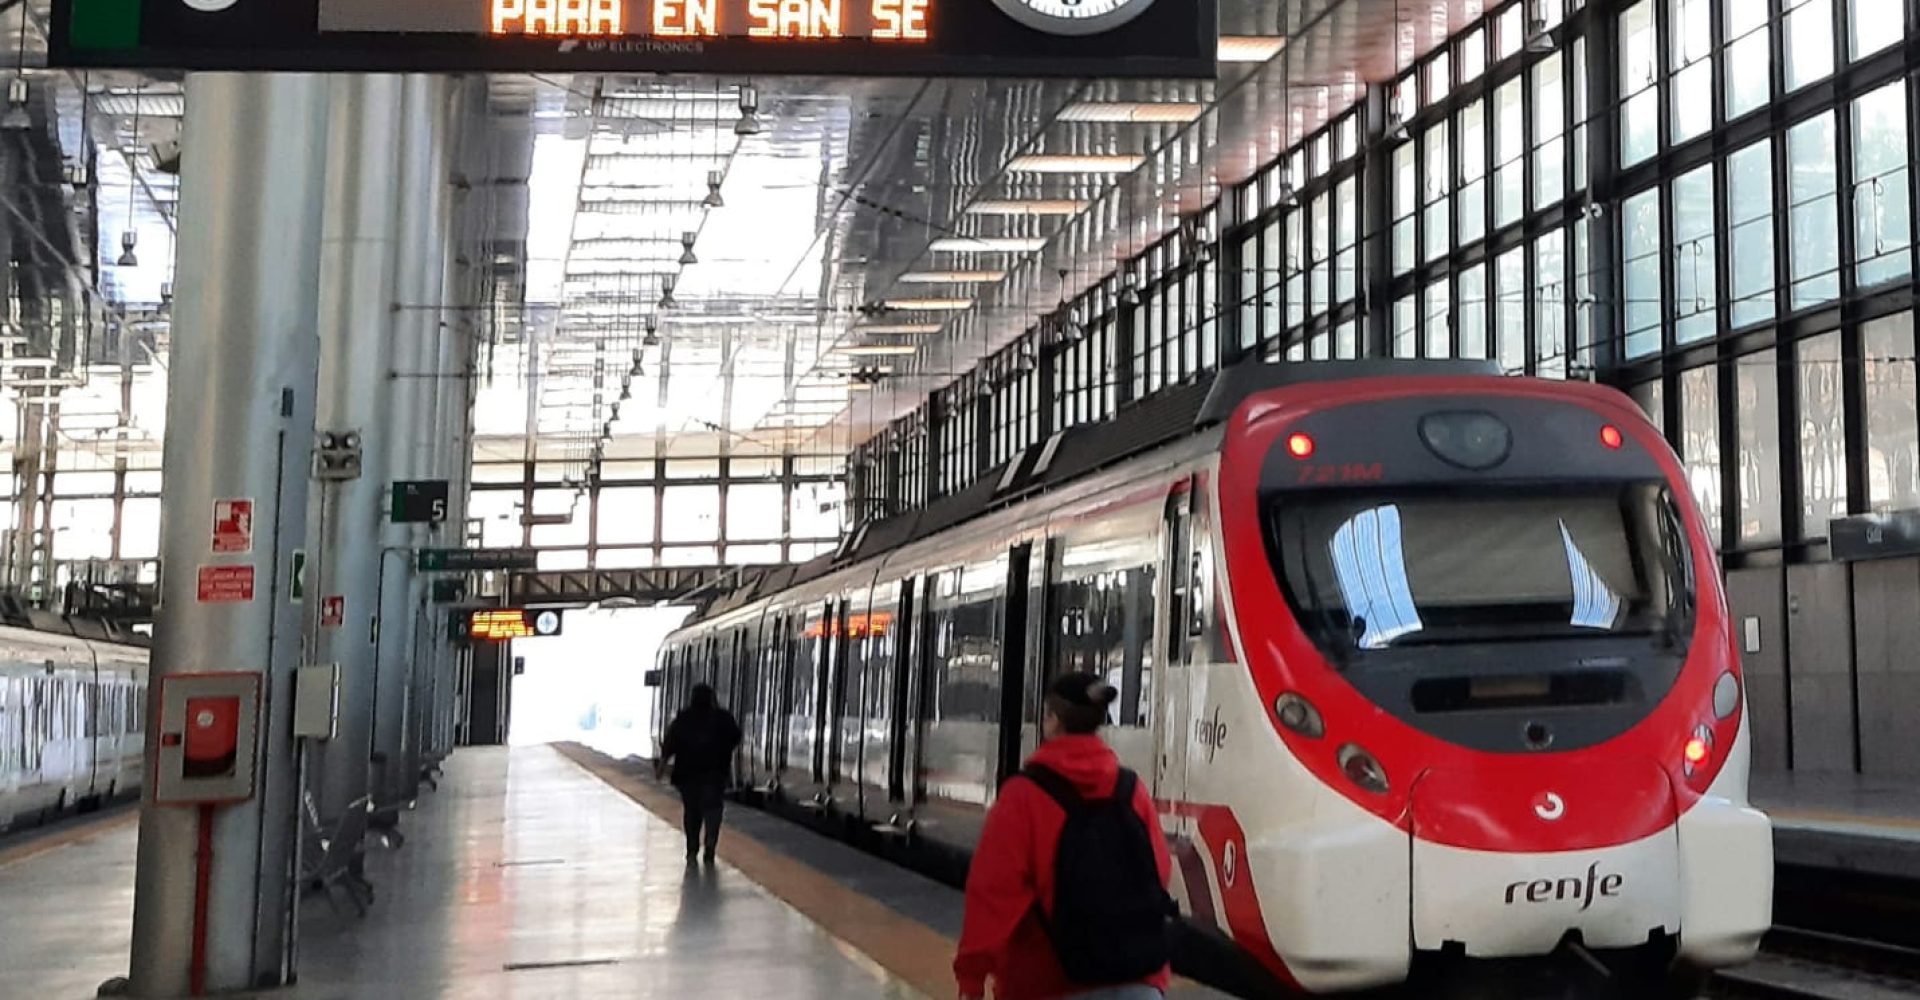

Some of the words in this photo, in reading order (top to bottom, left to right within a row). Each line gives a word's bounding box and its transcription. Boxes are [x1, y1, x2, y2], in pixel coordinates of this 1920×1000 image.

[491, 0, 623, 35] PARA
[653, 0, 719, 36] EN
[748, 0, 843, 38] SAN
[871, 0, 928, 39] SE
[609, 41, 704, 53] ELECTRONICS
[431, 498, 446, 522] 5
[1194, 703, 1227, 765] renfe
[1504, 860, 1623, 914] renfe
